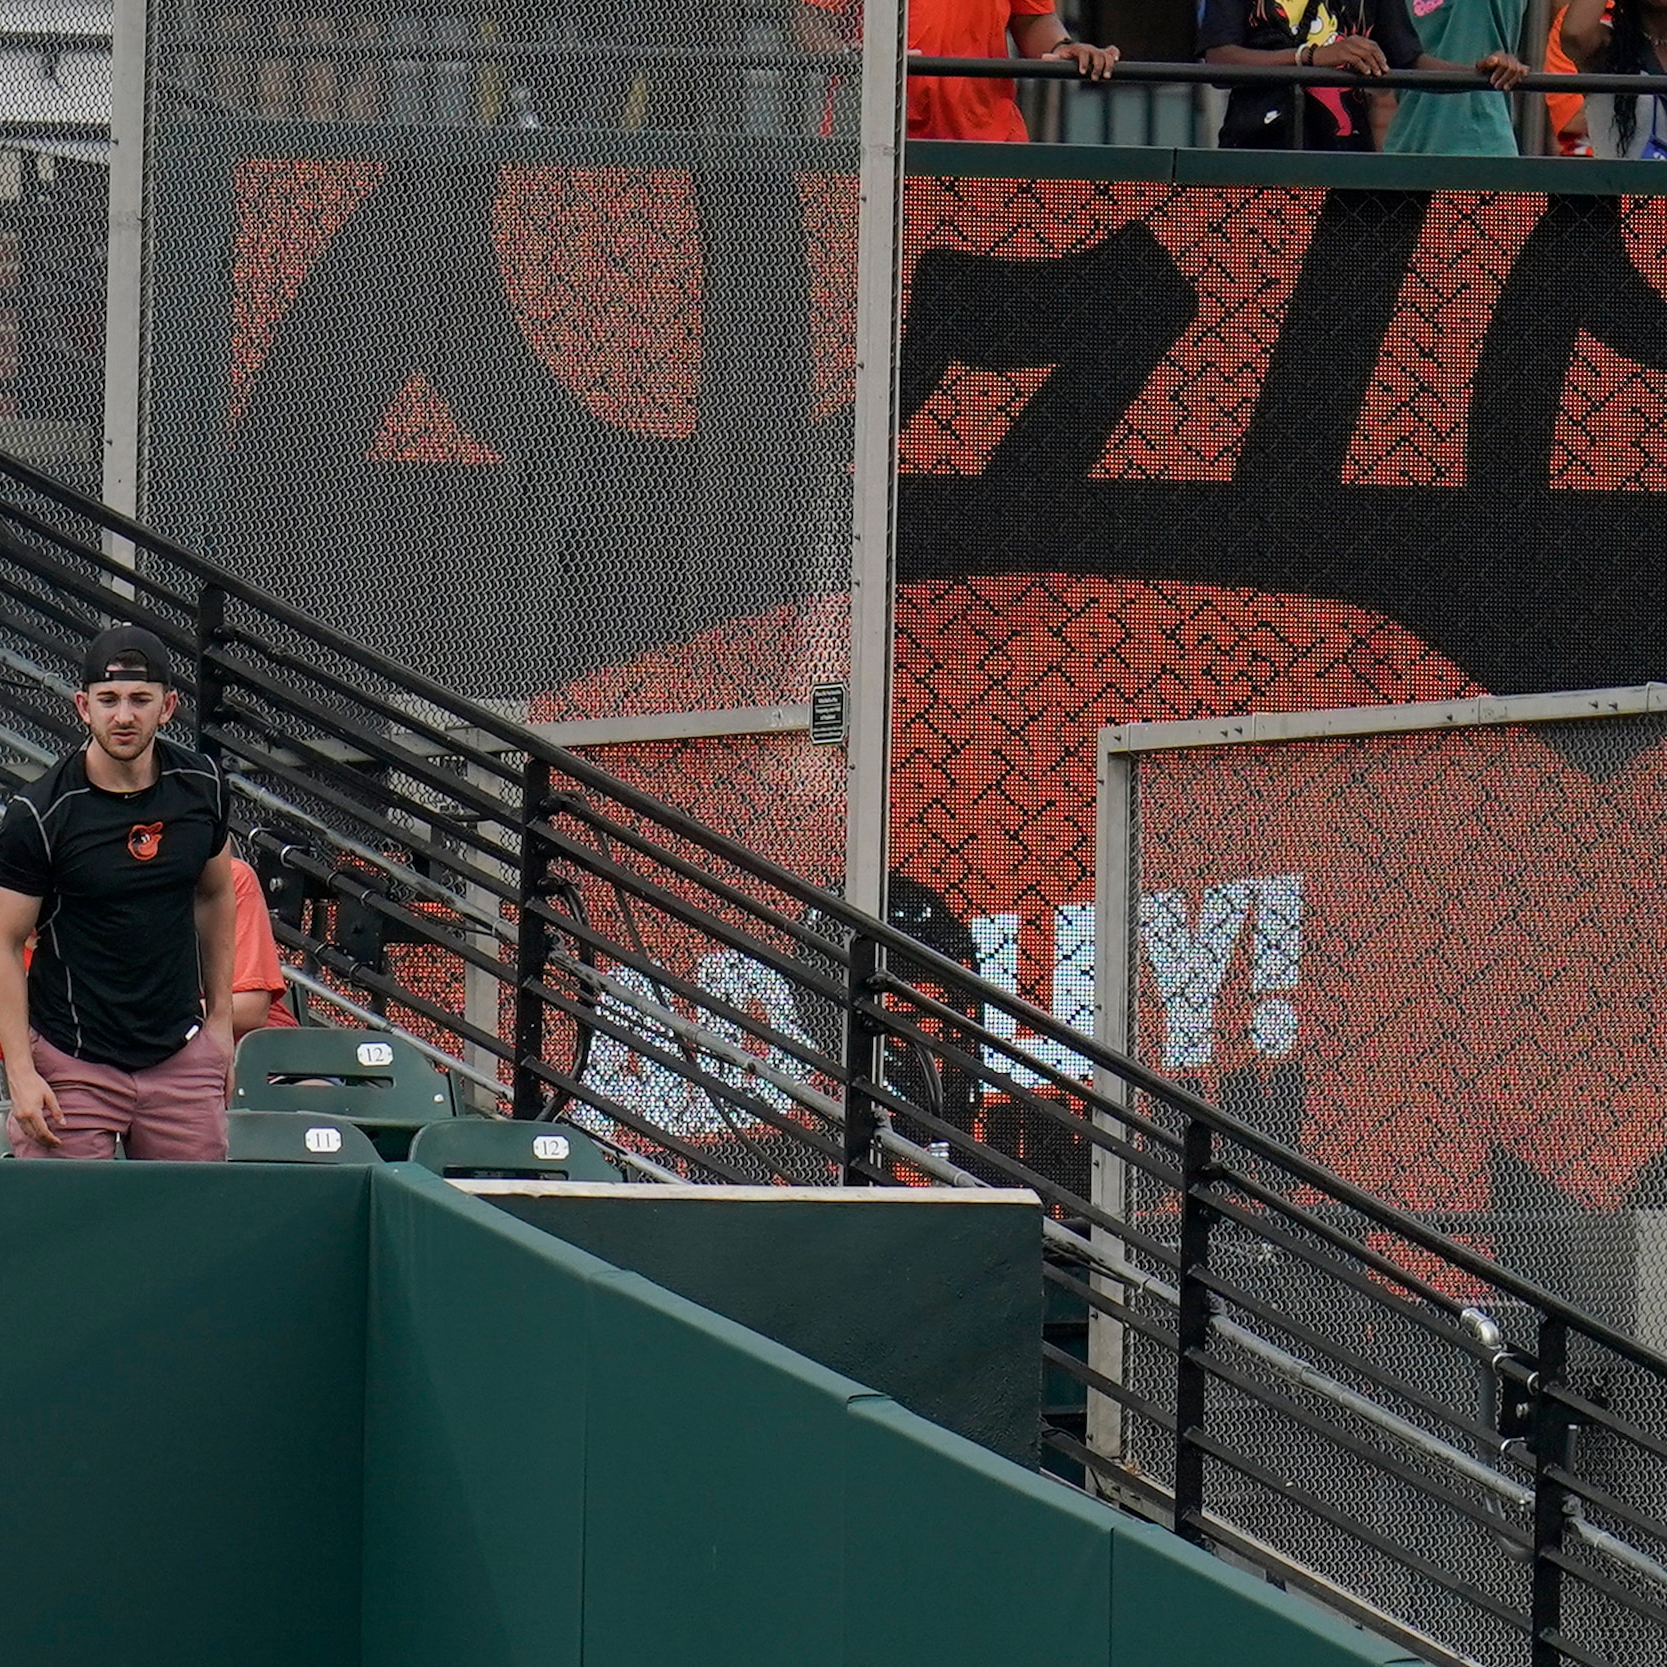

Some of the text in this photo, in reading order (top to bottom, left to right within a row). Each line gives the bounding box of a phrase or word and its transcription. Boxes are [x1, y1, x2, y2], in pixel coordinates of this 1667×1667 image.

[367, 1047, 383, 1062] 12
[315, 1133, 331, 1148] 11
[543, 1140, 559, 1155] 12
